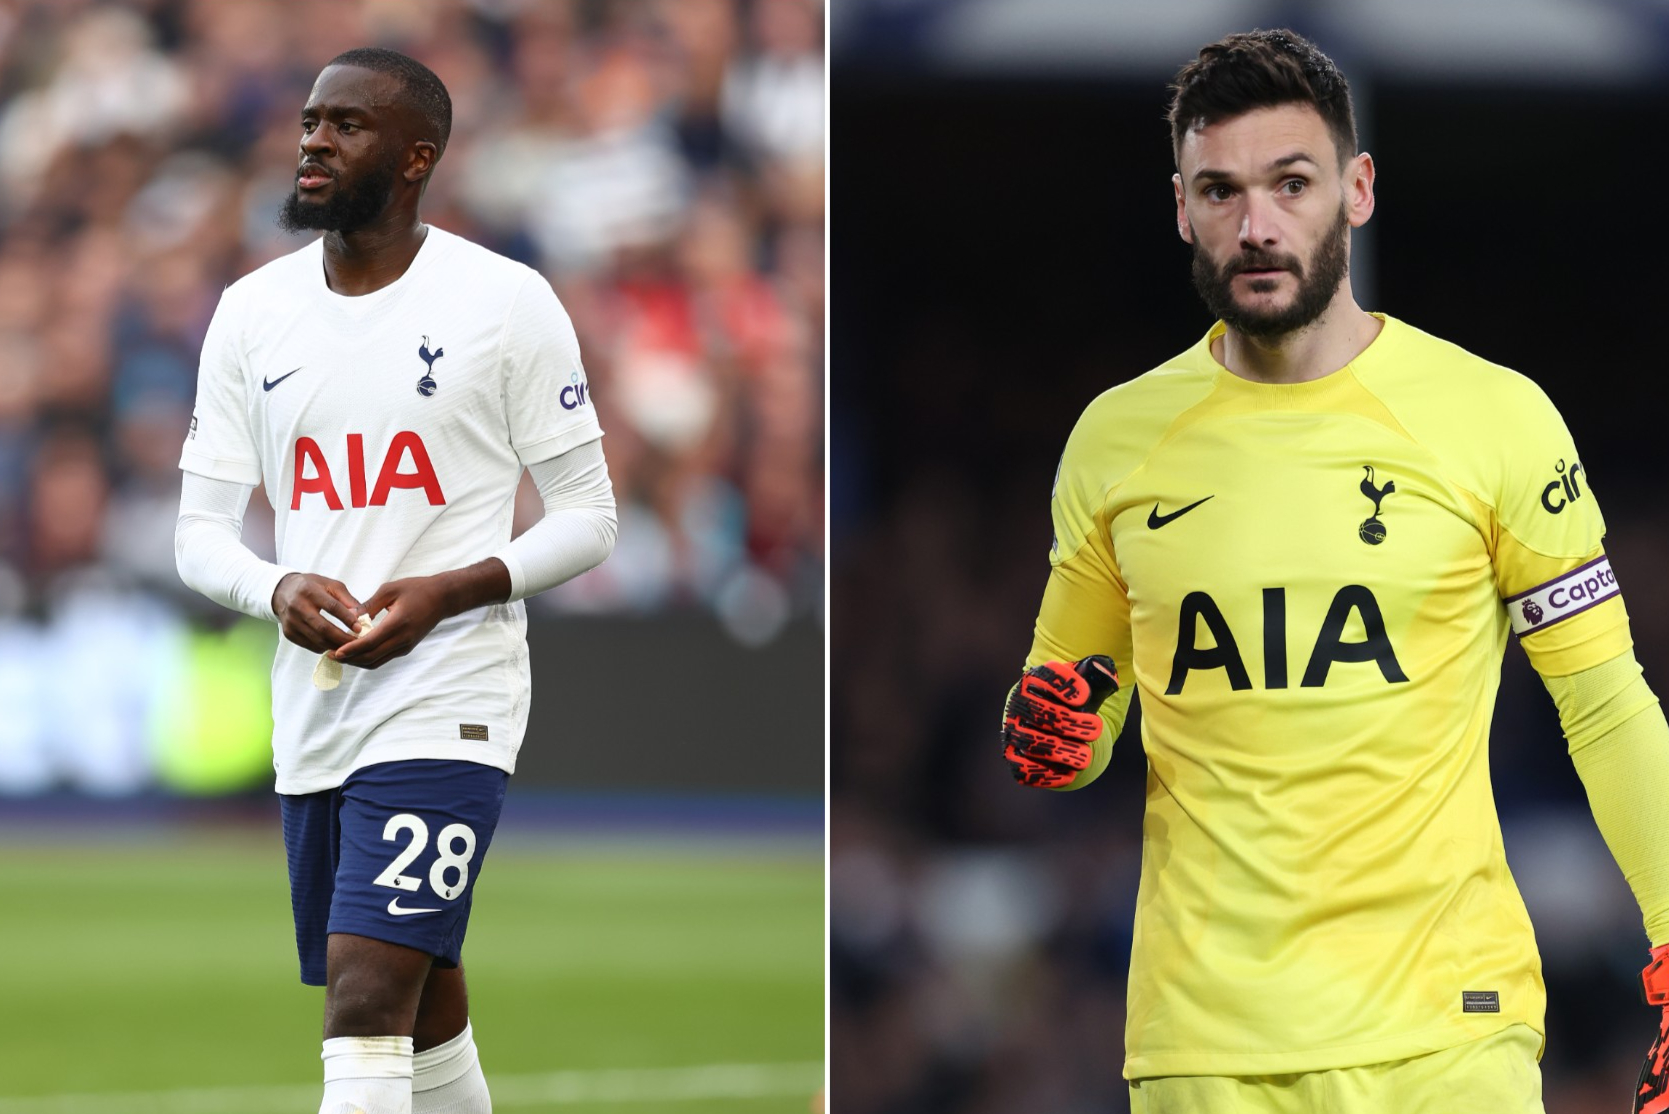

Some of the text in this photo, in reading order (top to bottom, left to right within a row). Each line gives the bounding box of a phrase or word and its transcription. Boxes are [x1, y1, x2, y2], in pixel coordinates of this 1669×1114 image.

[291, 431, 446, 511] AIA
[1165, 585, 1409, 696] AIA
[373, 814, 477, 901] 28
